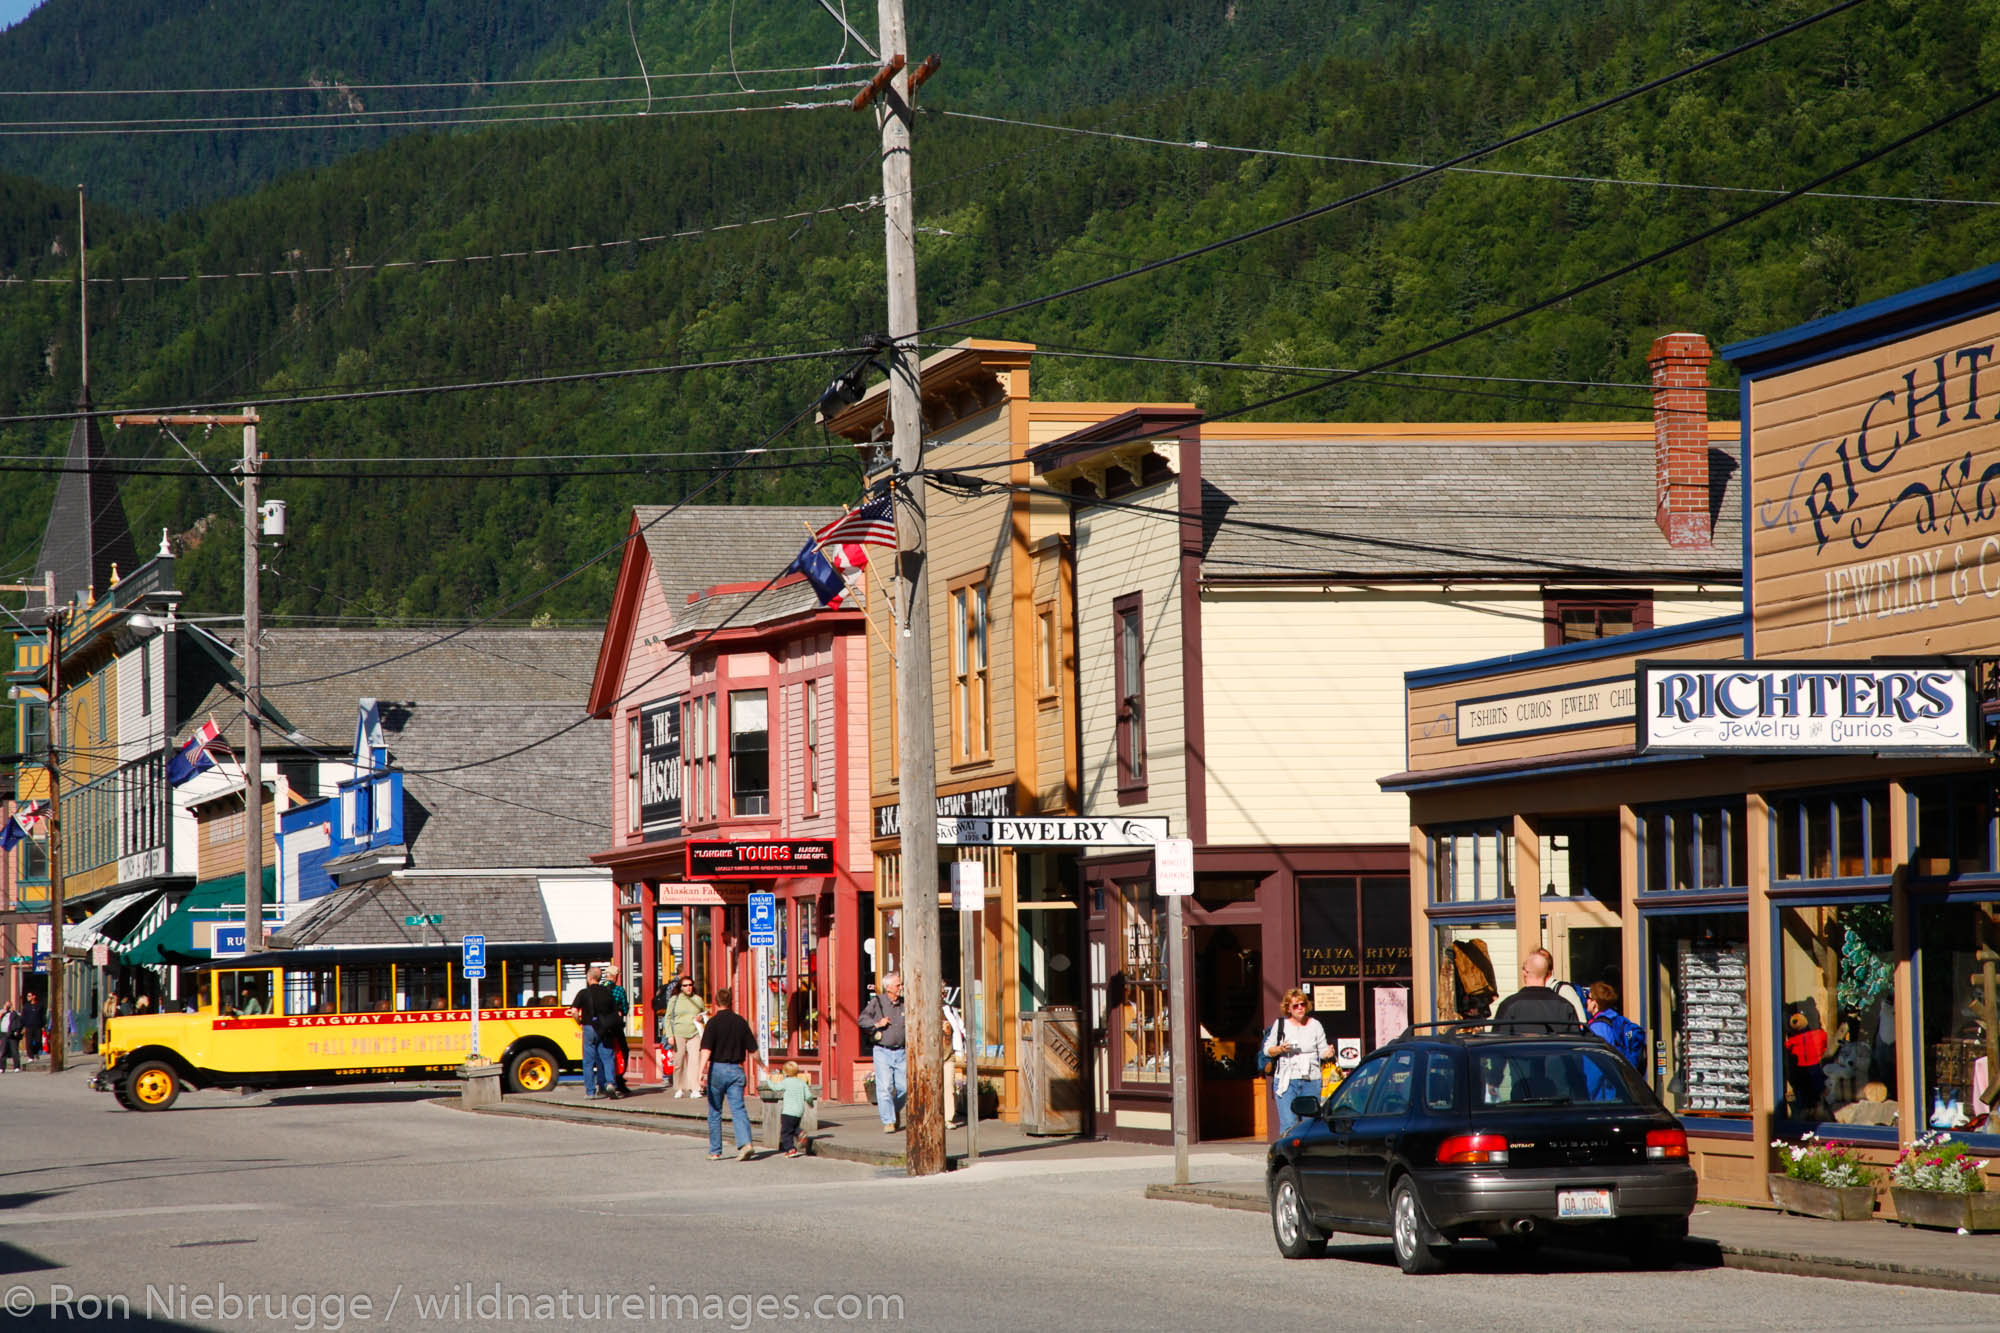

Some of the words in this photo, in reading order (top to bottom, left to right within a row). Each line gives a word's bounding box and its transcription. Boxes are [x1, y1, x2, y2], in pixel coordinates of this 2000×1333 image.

[1806, 343, 2000, 556] RICHT
[1824, 549, 1944, 649] JEWELRY
[1951, 544, 1969, 605] &
[1656, 671, 1954, 723] RICHTER'S
[1470, 706, 1508, 728] T-SHIRTS
[1516, 700, 1552, 722] CURIOS
[1561, 692, 1600, 720] JEWELRY
[652, 711, 671, 747] THE
[1718, 720, 1800, 742] Jewelry
[1830, 719, 1894, 743] Curios
[642, 753, 680, 806] MASCOT
[982, 822, 1108, 841] JEWELRY
[694, 849, 733, 858] KLONDIKE
[736, 845, 791, 861] TOURS
[1159, 871, 1190, 880] PARKING
[663, 886, 699, 895] Alaskan
[1303, 948, 1354, 959] TAIYA
[1309, 964, 1397, 976] JEWELRY
[288, 1015, 381, 1026] SKAGWAY
[393, 1012, 470, 1022] ALASKA
[479, 1009, 553, 1019] STREET
[322, 1038, 347, 1056] ALL
[351, 1036, 397, 1055] POINTS
[413, 1032, 475, 1054] INTEREST
